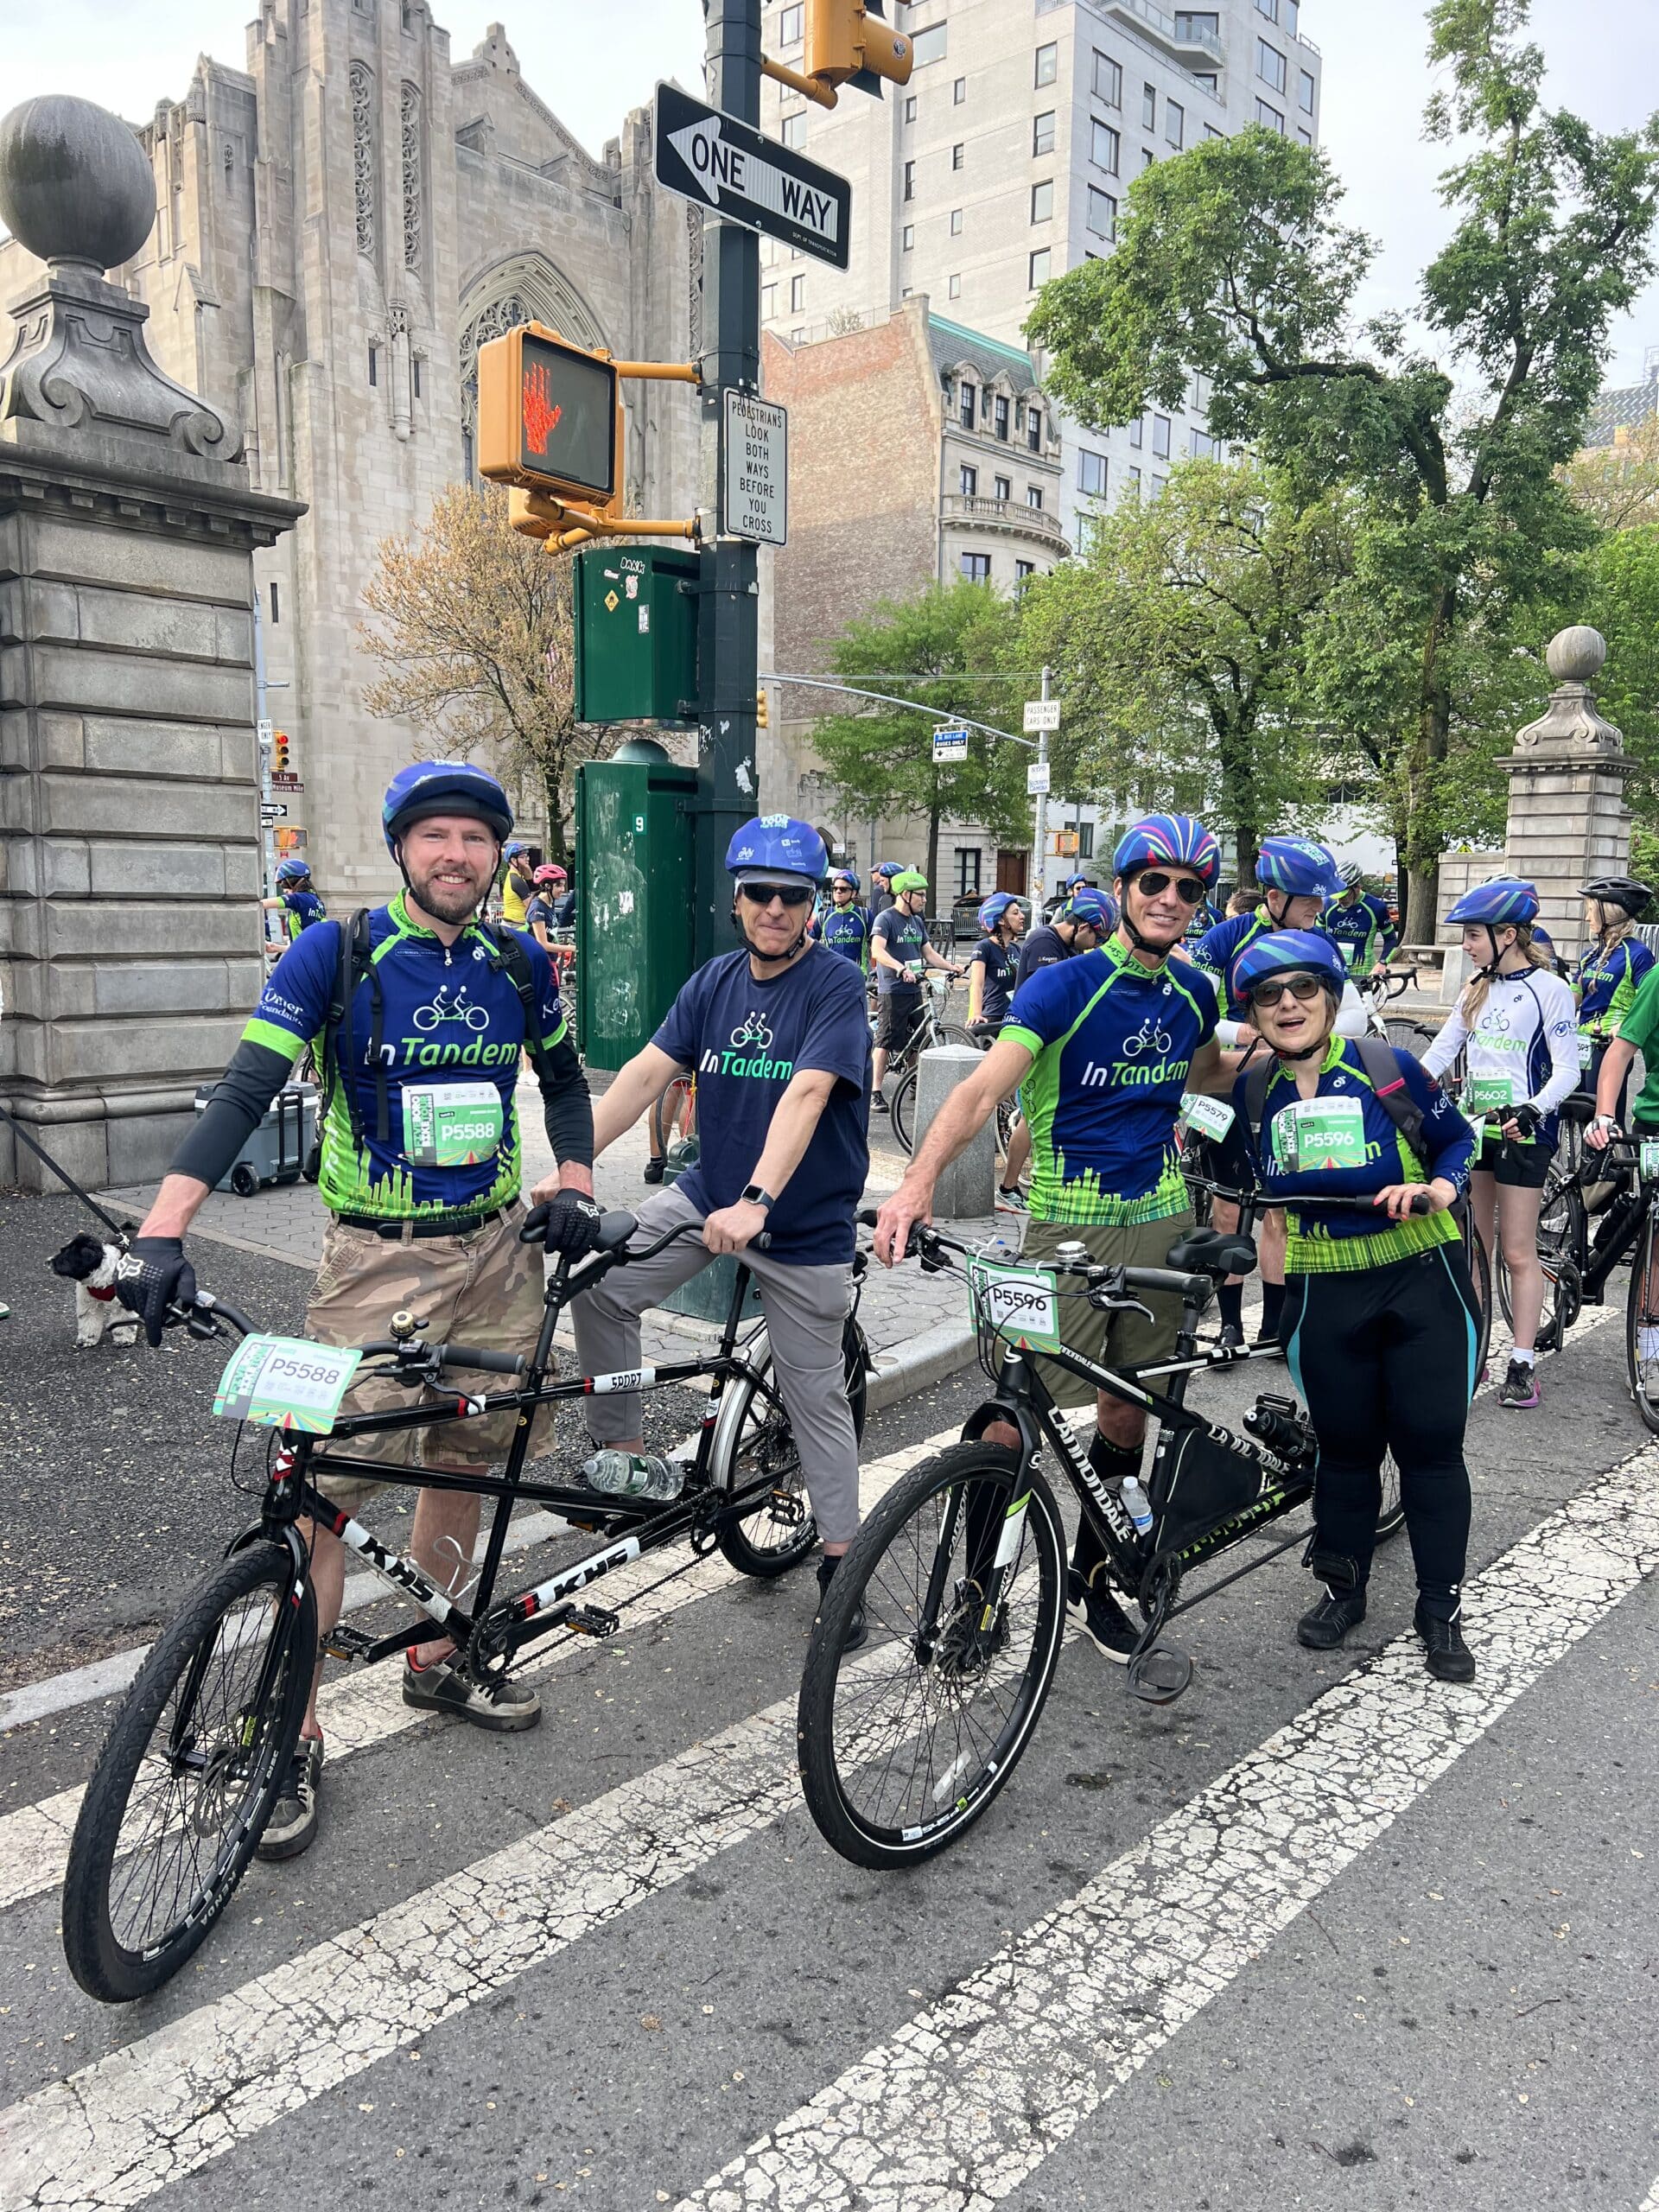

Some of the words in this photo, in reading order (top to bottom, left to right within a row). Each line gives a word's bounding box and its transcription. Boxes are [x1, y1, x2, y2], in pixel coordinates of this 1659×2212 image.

[692, 133, 745, 192] ONE
[782, 176, 831, 231] WAY
[732, 401, 782, 429] PEDESTRIANS
[745, 424, 769, 442] LOOK
[746, 442, 769, 461] BOTH
[746, 461, 769, 479] WAYS
[740, 477, 775, 499] BEFORE
[748, 498, 766, 514] YOU
[742, 515, 772, 534] CROSS
[1027, 705, 1058, 714] PASSENGER
[1043, 715, 1056, 724] ONLY
[636, 817, 643, 831] 9
[1475, 1090, 1508, 1100] P5602
[1198, 1101, 1228, 1121] P5579
[442, 1122, 495, 1141] P5588
[1304, 1131, 1355, 1148] P5596
[993, 1287, 1046, 1311] P5596
[270, 1357, 340, 1384] P5588
[610, 1372, 642, 1390] SPORT
[200, 1870, 238, 1927] KENDA
